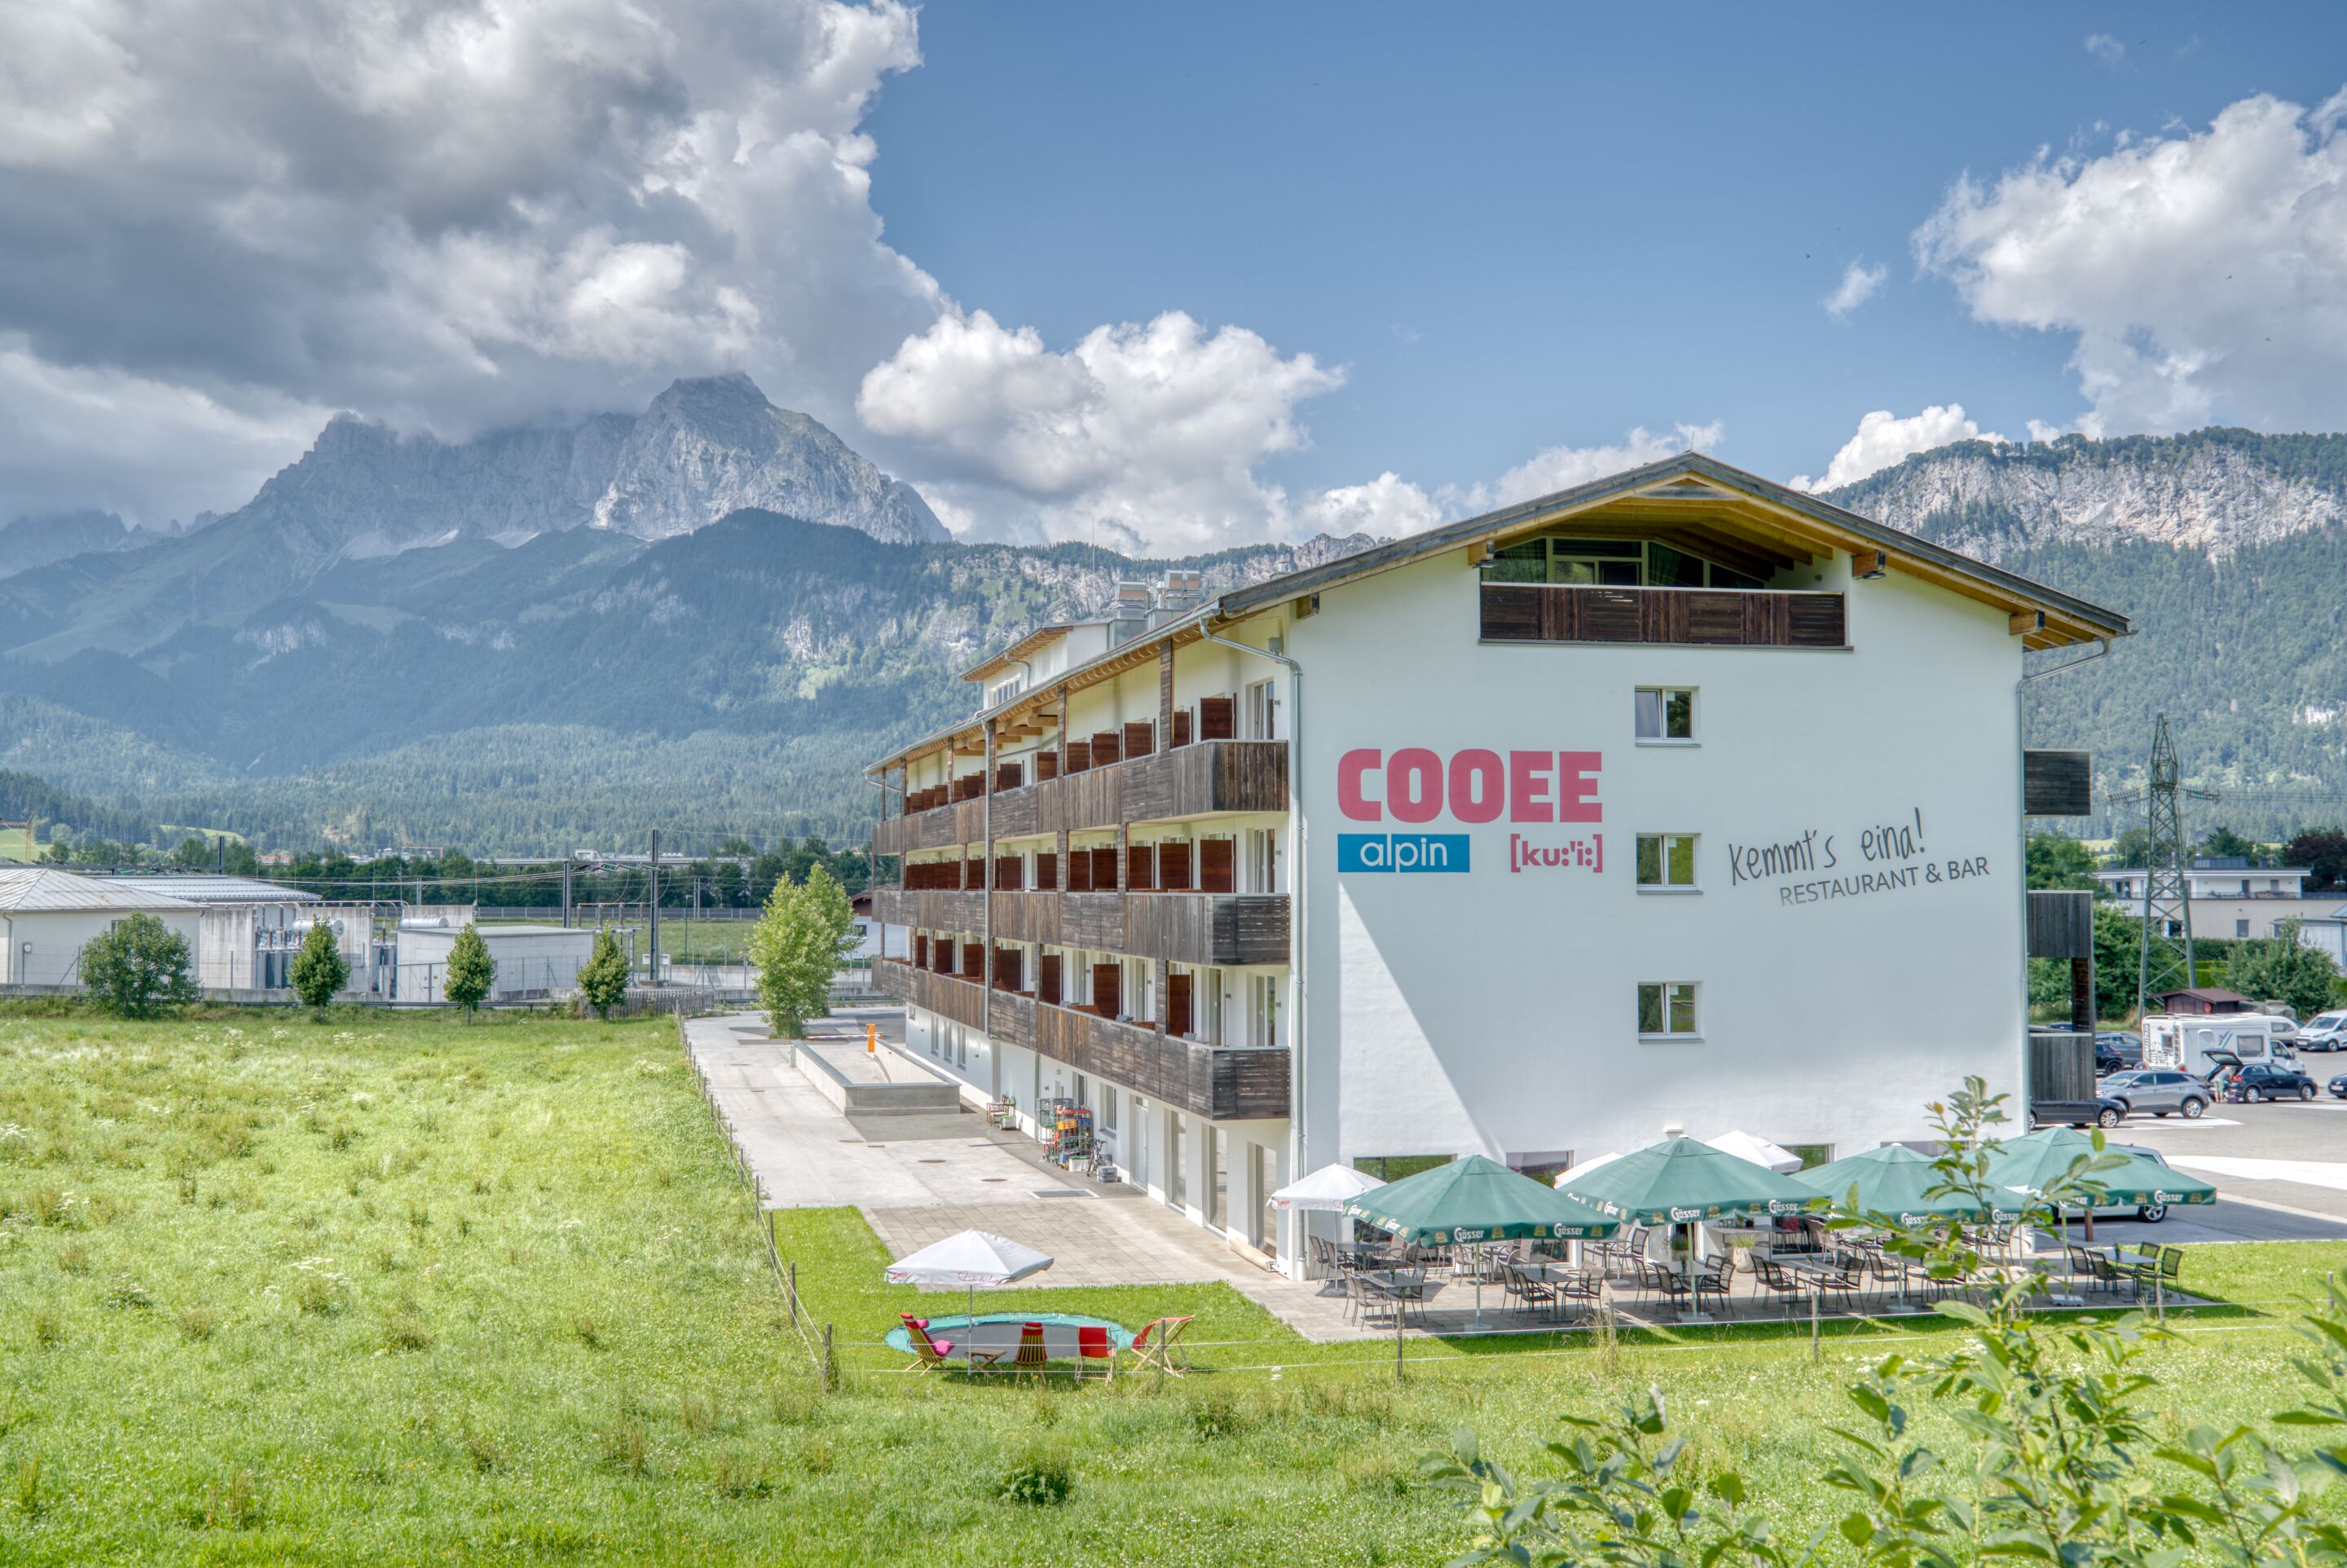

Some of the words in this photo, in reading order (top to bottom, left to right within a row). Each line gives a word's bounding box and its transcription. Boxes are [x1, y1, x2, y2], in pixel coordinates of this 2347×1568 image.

[1337, 747, 1603, 823] COOEE
[1359, 834, 1448, 872] alpin
[1779, 866, 1919, 906] RESTAURANT
[1925, 862, 1943, 883] &
[1947, 857, 1991, 880] BAR
[1671, 1206, 1702, 1222] Gösser
[1768, 1199, 1799, 1214] Gösser
[1453, 1227, 1485, 1243] Gösser
[1553, 1222, 1584, 1238] Gösser
